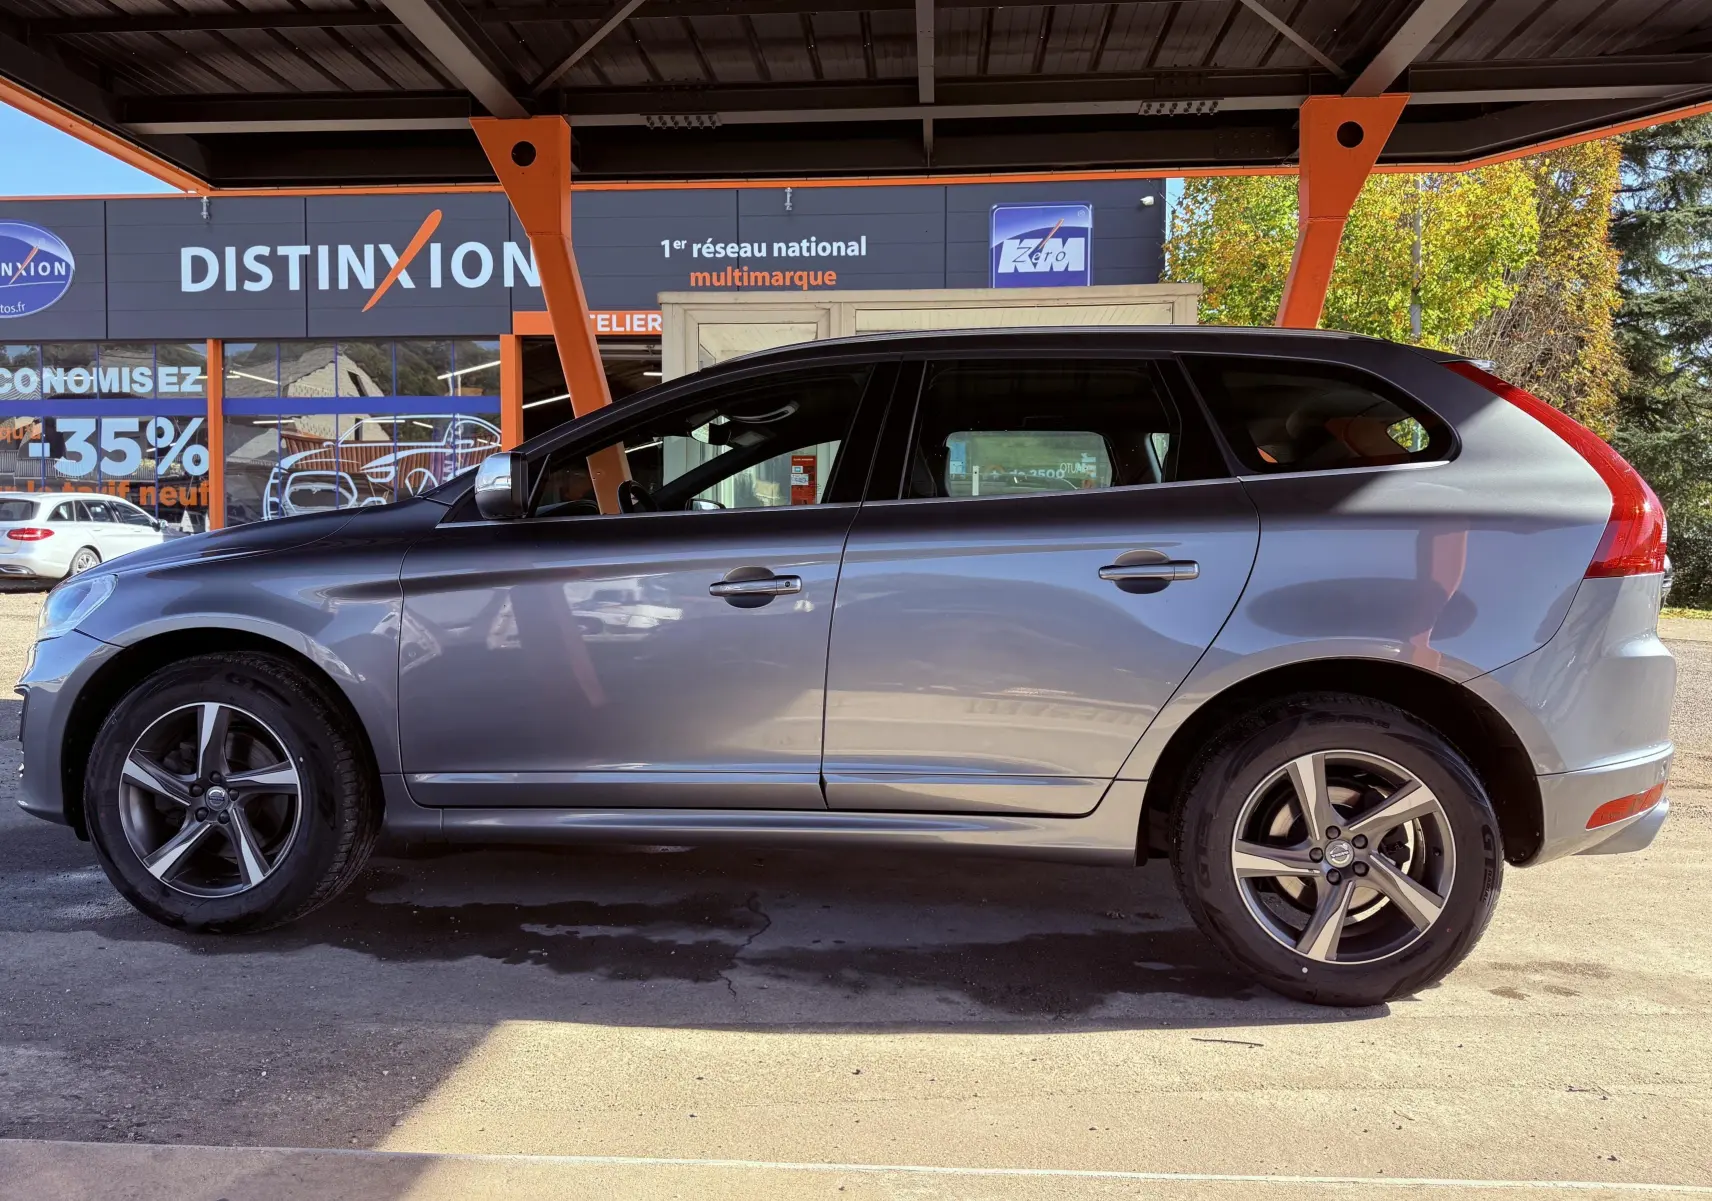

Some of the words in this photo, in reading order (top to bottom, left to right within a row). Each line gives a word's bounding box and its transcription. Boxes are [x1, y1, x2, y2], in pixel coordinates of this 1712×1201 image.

[693, 238, 767, 258] réseau
[773, 236, 867, 257] national
[1012, 246, 1067, 264] Zero
[181, 209, 541, 313] DISTINXION
[690, 266, 837, 290] multimarque
[28, 416, 209, 476] -35%
